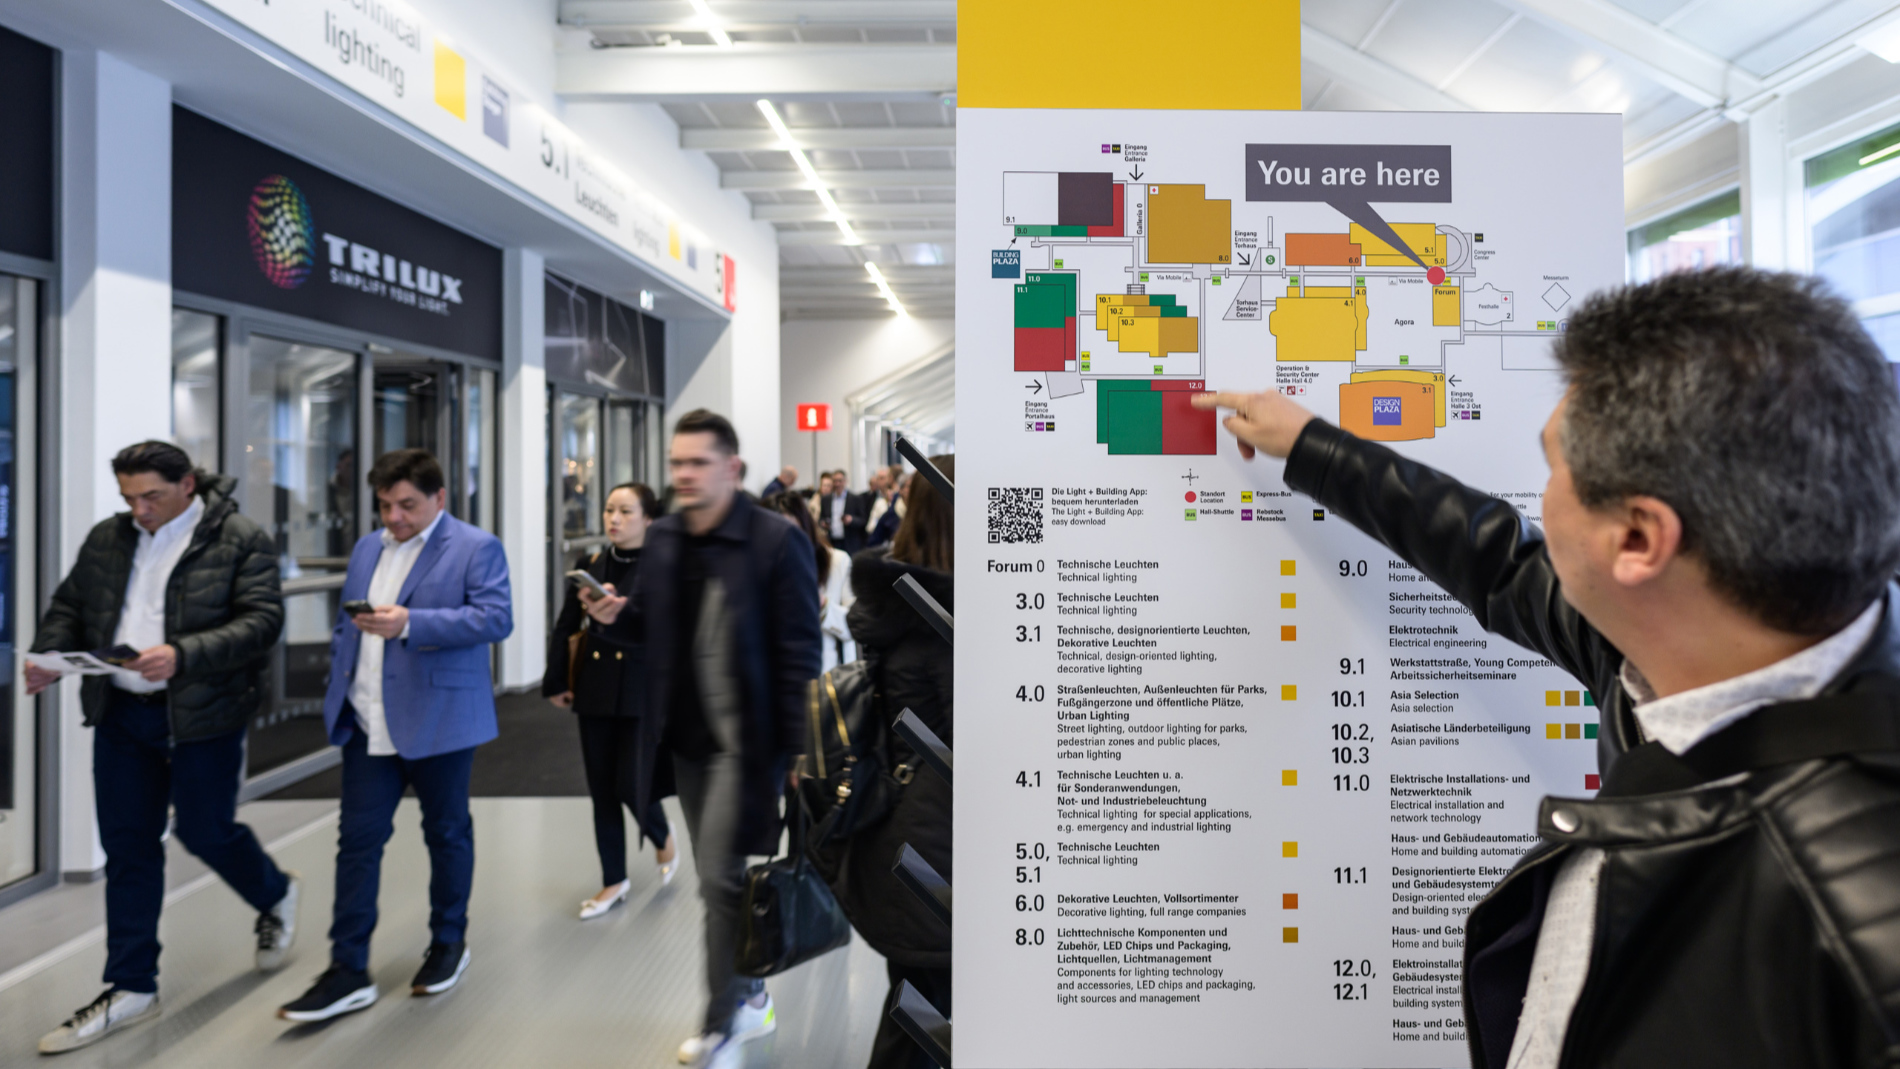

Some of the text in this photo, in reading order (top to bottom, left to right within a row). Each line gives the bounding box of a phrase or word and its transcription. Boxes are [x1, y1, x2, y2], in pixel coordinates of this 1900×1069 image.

[324, 10, 405, 98] lighting
[1258, 161, 1440, 187] You are here
[322, 232, 463, 305] TRILUX
[329, 268, 386, 297] SIMPLIFY
[390, 286, 416, 306] YOUR
[1067, 488, 1086, 496] Light
[1096, 488, 1127, 496] Building
[1130, 488, 1147, 496] App:
[1052, 498, 1082, 506] bequem
[1067, 508, 1085, 516] Light
[1095, 508, 1124, 516] Building
[1127, 508, 1143, 516] App:
[988, 560, 1044, 572] Forum 0
[1057, 560, 1158, 568] Technische Leuchten
[1339, 560, 1367, 576] 9.0
[1057, 572, 1137, 583] Technical lighting
[1016, 593, 1044, 610] 3.0
[1016, 625, 1040, 642] 3.1
[1057, 625, 1250, 636] Technische, designorientierte Leuchten,
[1390, 625, 1458, 634] Elektrotechnik
[1058, 638, 1156, 647] Dekorative Leuchten
[1390, 638, 1486, 649] Electrical engineering
[1057, 651, 1216, 662] Technical, design-oriented lighting,
[1057, 664, 1142, 675] decorative lighting
[1340, 658, 1364, 674] 9.1
[1390, 671, 1516, 680] Arbeitssicherheitseminare
[1016, 685, 1044, 702] 4.0
[1332, 691, 1364, 707] 10.1
[1390, 690, 1459, 699] Asia Selection
[1391, 703, 1453, 712] Asia selection
[1332, 724, 1374, 742] 10.2,
[1391, 723, 1530, 734] Asiatische Länderbeteiligung
[1391, 736, 1459, 747] Asian pavilions
[1332, 747, 1369, 764] 10.3
[1016, 771, 1040, 787] 4.1
[1334, 774, 1369, 791] 11.0
[1391, 787, 1472, 796] Netzwerktechnik
[1391, 813, 1481, 824] network technology
[1016, 843, 1049, 862] 5.0,
[1016, 866, 1040, 883] 5.1
[1334, 867, 1366, 884] 11.1
[1016, 894, 1044, 911] 6.0
[1058, 894, 1238, 904] Dekorative Leuchten, Vollsortimenter
[1058, 907, 1246, 918] Decorative lighting, full range companies
[1016, 928, 1044, 945] 8.0
[1058, 928, 1227, 938] Lichttechnische Komponenten und
[1058, 954, 1211, 965] Lichtquellen, Lichtmanagement
[1334, 960, 1376, 978] 12.0,
[1334, 983, 1366, 1000] 12.1
